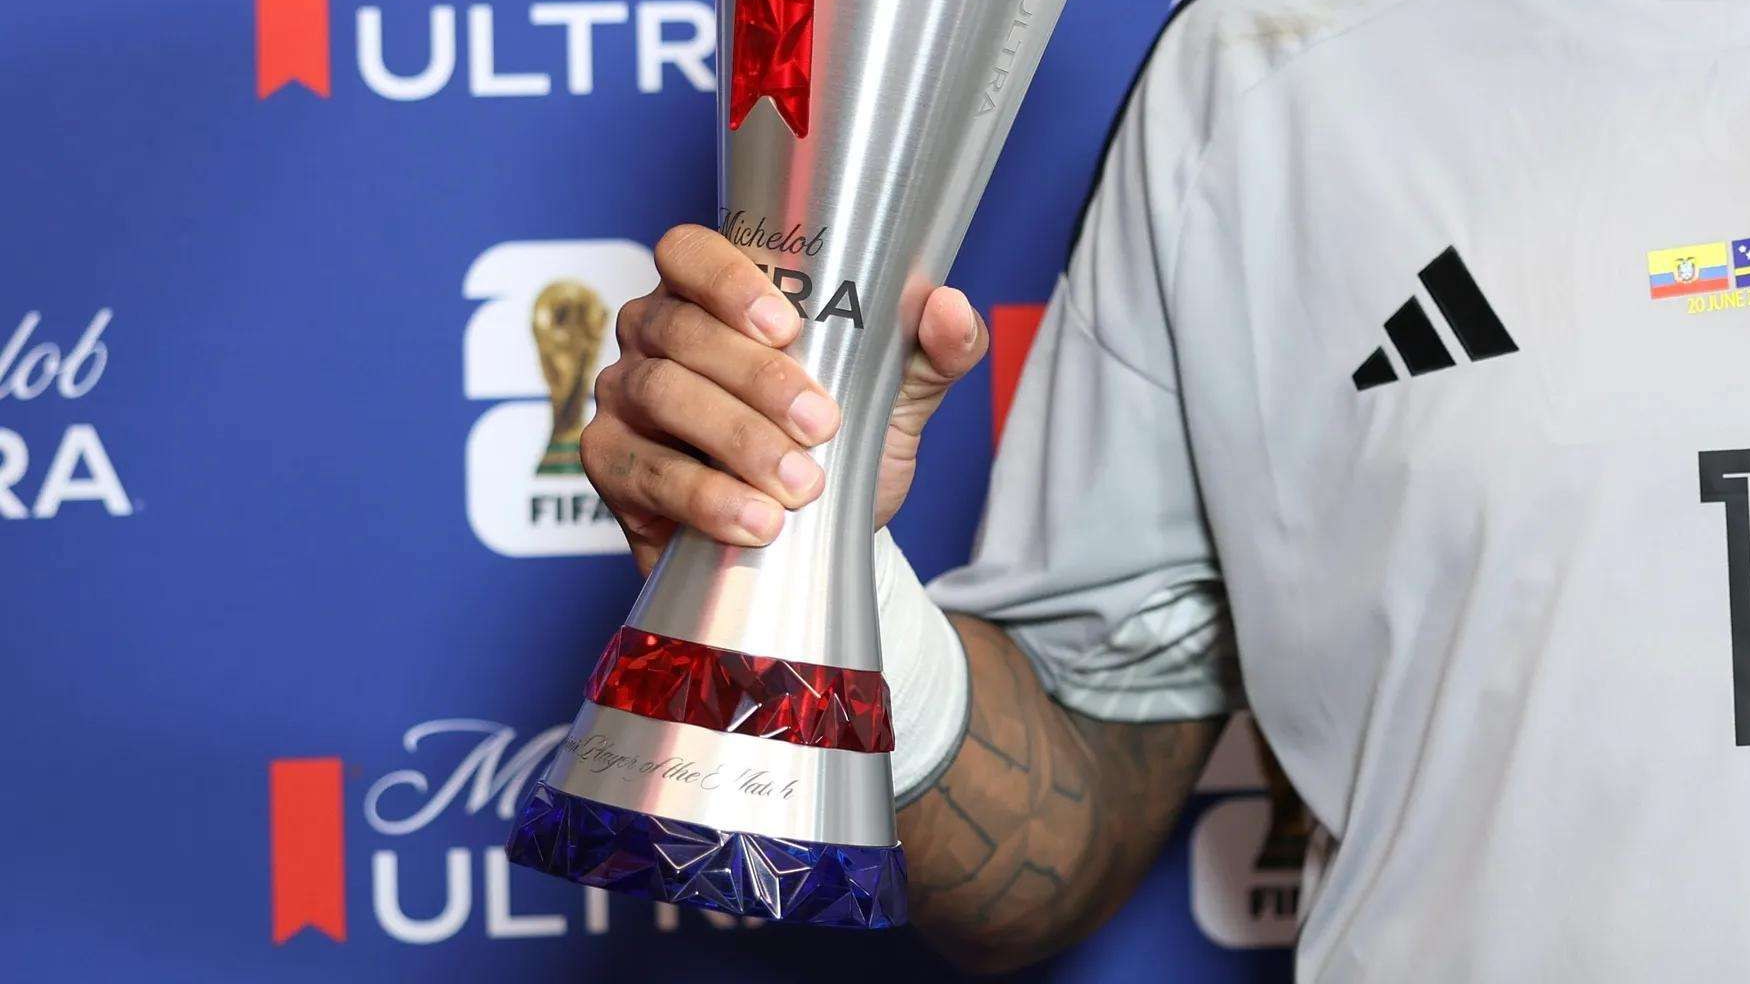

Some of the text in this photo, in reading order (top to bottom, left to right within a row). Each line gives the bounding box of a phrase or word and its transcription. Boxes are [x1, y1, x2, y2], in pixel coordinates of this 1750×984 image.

[1687, 298, 1704, 314] 20
[1706, 291, 1745, 312] JUNE
[1249, 884, 1299, 920] FI
